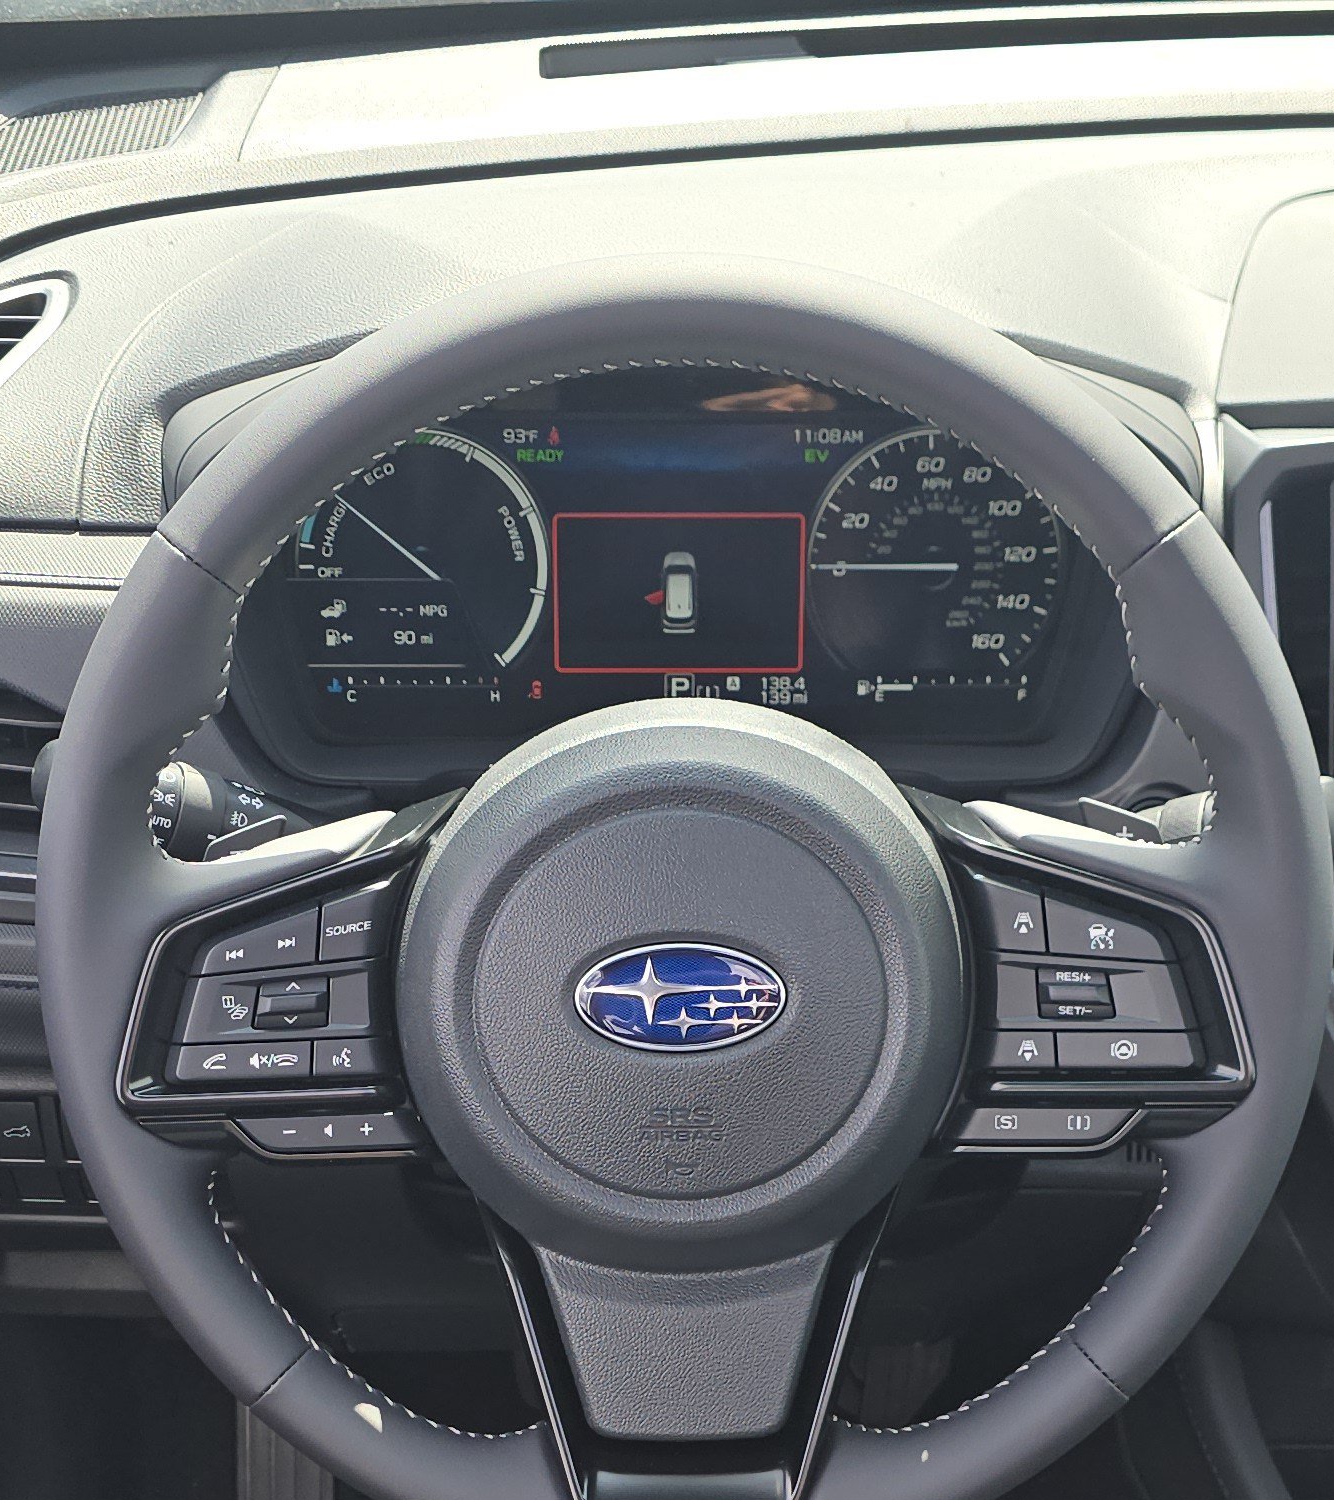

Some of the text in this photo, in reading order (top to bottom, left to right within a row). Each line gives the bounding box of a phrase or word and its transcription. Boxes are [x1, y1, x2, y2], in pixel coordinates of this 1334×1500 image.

[516, 449, 564, 462] READY
[804, 449, 830, 462] EV
[916, 456, 945, 473] 60
[363, 462, 395, 487] ECO
[962, 466, 992, 483] 80
[869, 476, 898, 492] 40
[988, 500, 1022, 516] 100
[841, 513, 869, 529] 20
[497, 505, 525, 563] POWER
[1004, 546, 1037, 562] 120
[317, 566, 344, 578] OFF
[997, 594, 1030, 610] 140
[394, 630, 433, 646] 90 mi
[972, 633, 1005, 650] 160
[671, 678, 690, 697] P
[761, 677, 805, 690] 138.4
[347, 690, 357, 703] C
[490, 690, 500, 702] H
[761, 690, 808, 704] 139 mi
[875, 690, 884, 703] E
[151, 814, 172, 829] UTO
[325, 920, 372, 937] SOURCE
[1055, 972, 1091, 982] RES/+
